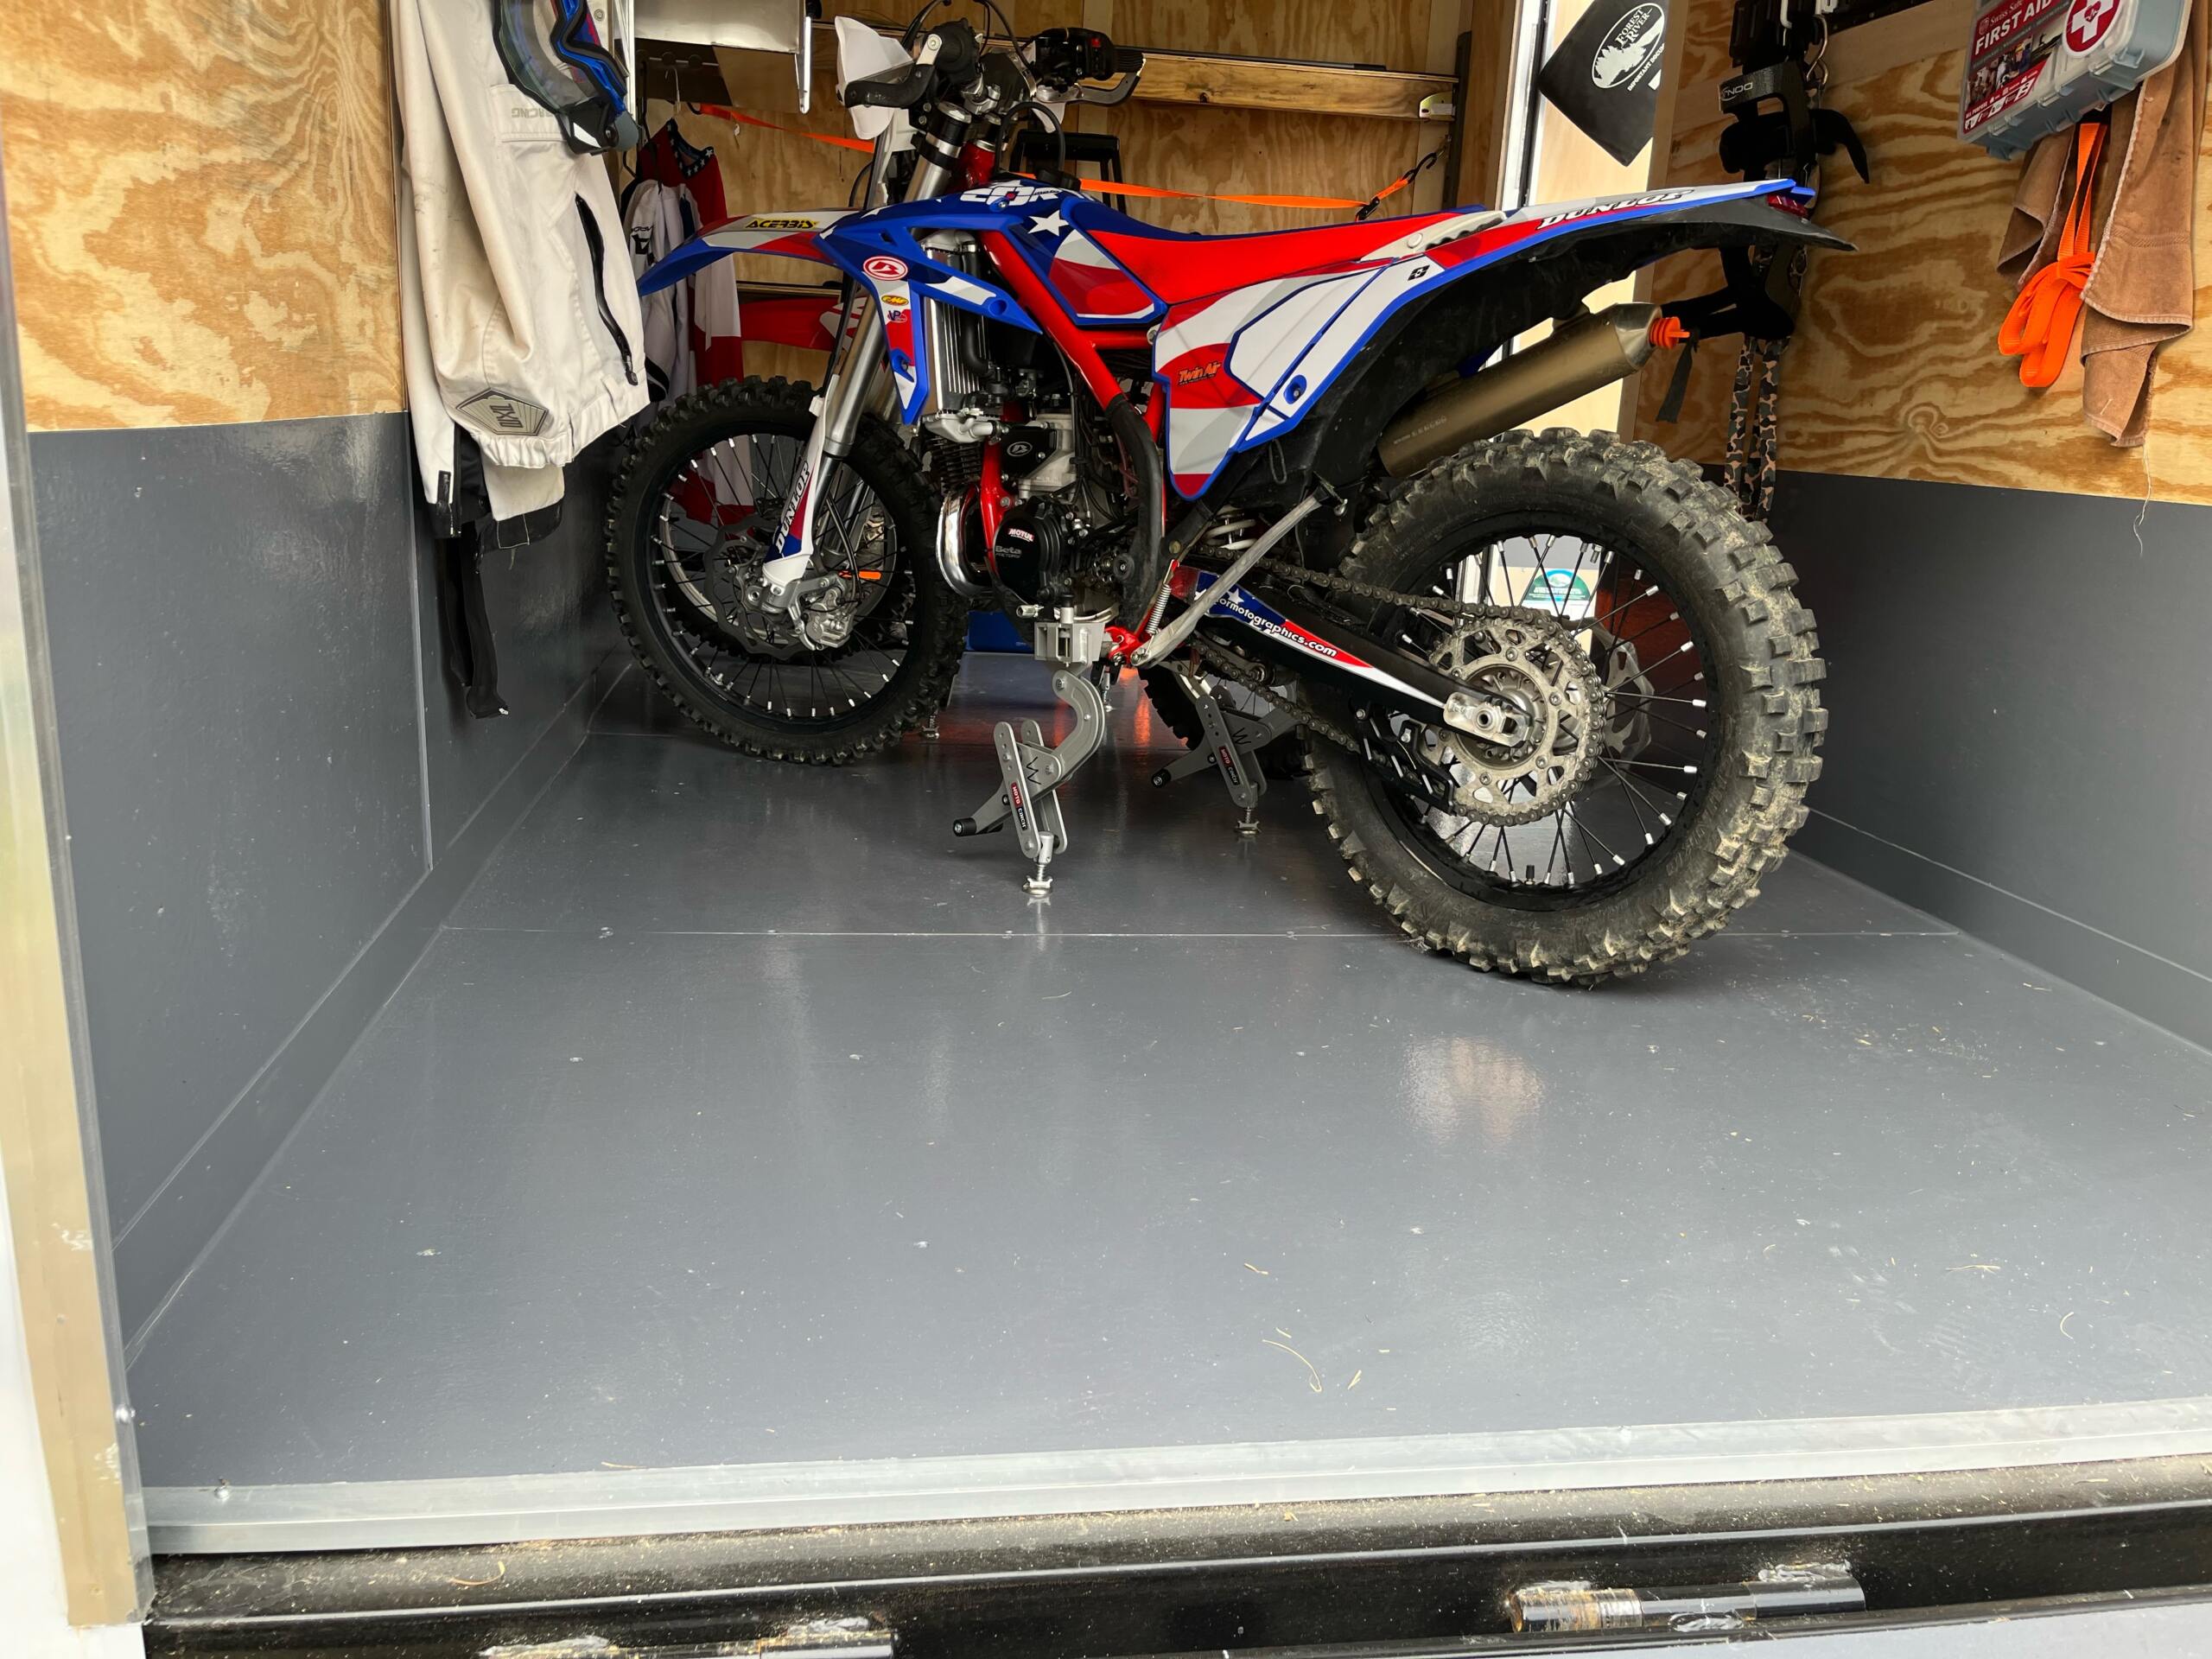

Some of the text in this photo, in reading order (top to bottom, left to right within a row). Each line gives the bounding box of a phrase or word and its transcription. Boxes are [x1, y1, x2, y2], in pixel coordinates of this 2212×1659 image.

[1615, 7, 1645, 46] FOREST
[1627, 12, 1650, 43] RIVER
[1974, 11, 2023, 55] FIRST
[1627, 61, 1652, 92] IMPORTANT
[1536, 188, 1695, 230] DUNLOP
[1179, 366, 1205, 383] Twin
[776, 460, 810, 554] DUNLOP
[995, 545, 1022, 555] Beta
[1007, 528, 1034, 543] MOTUL
[1220, 748, 1231, 765] MOTO
[1012, 785, 1021, 805] MOTO
